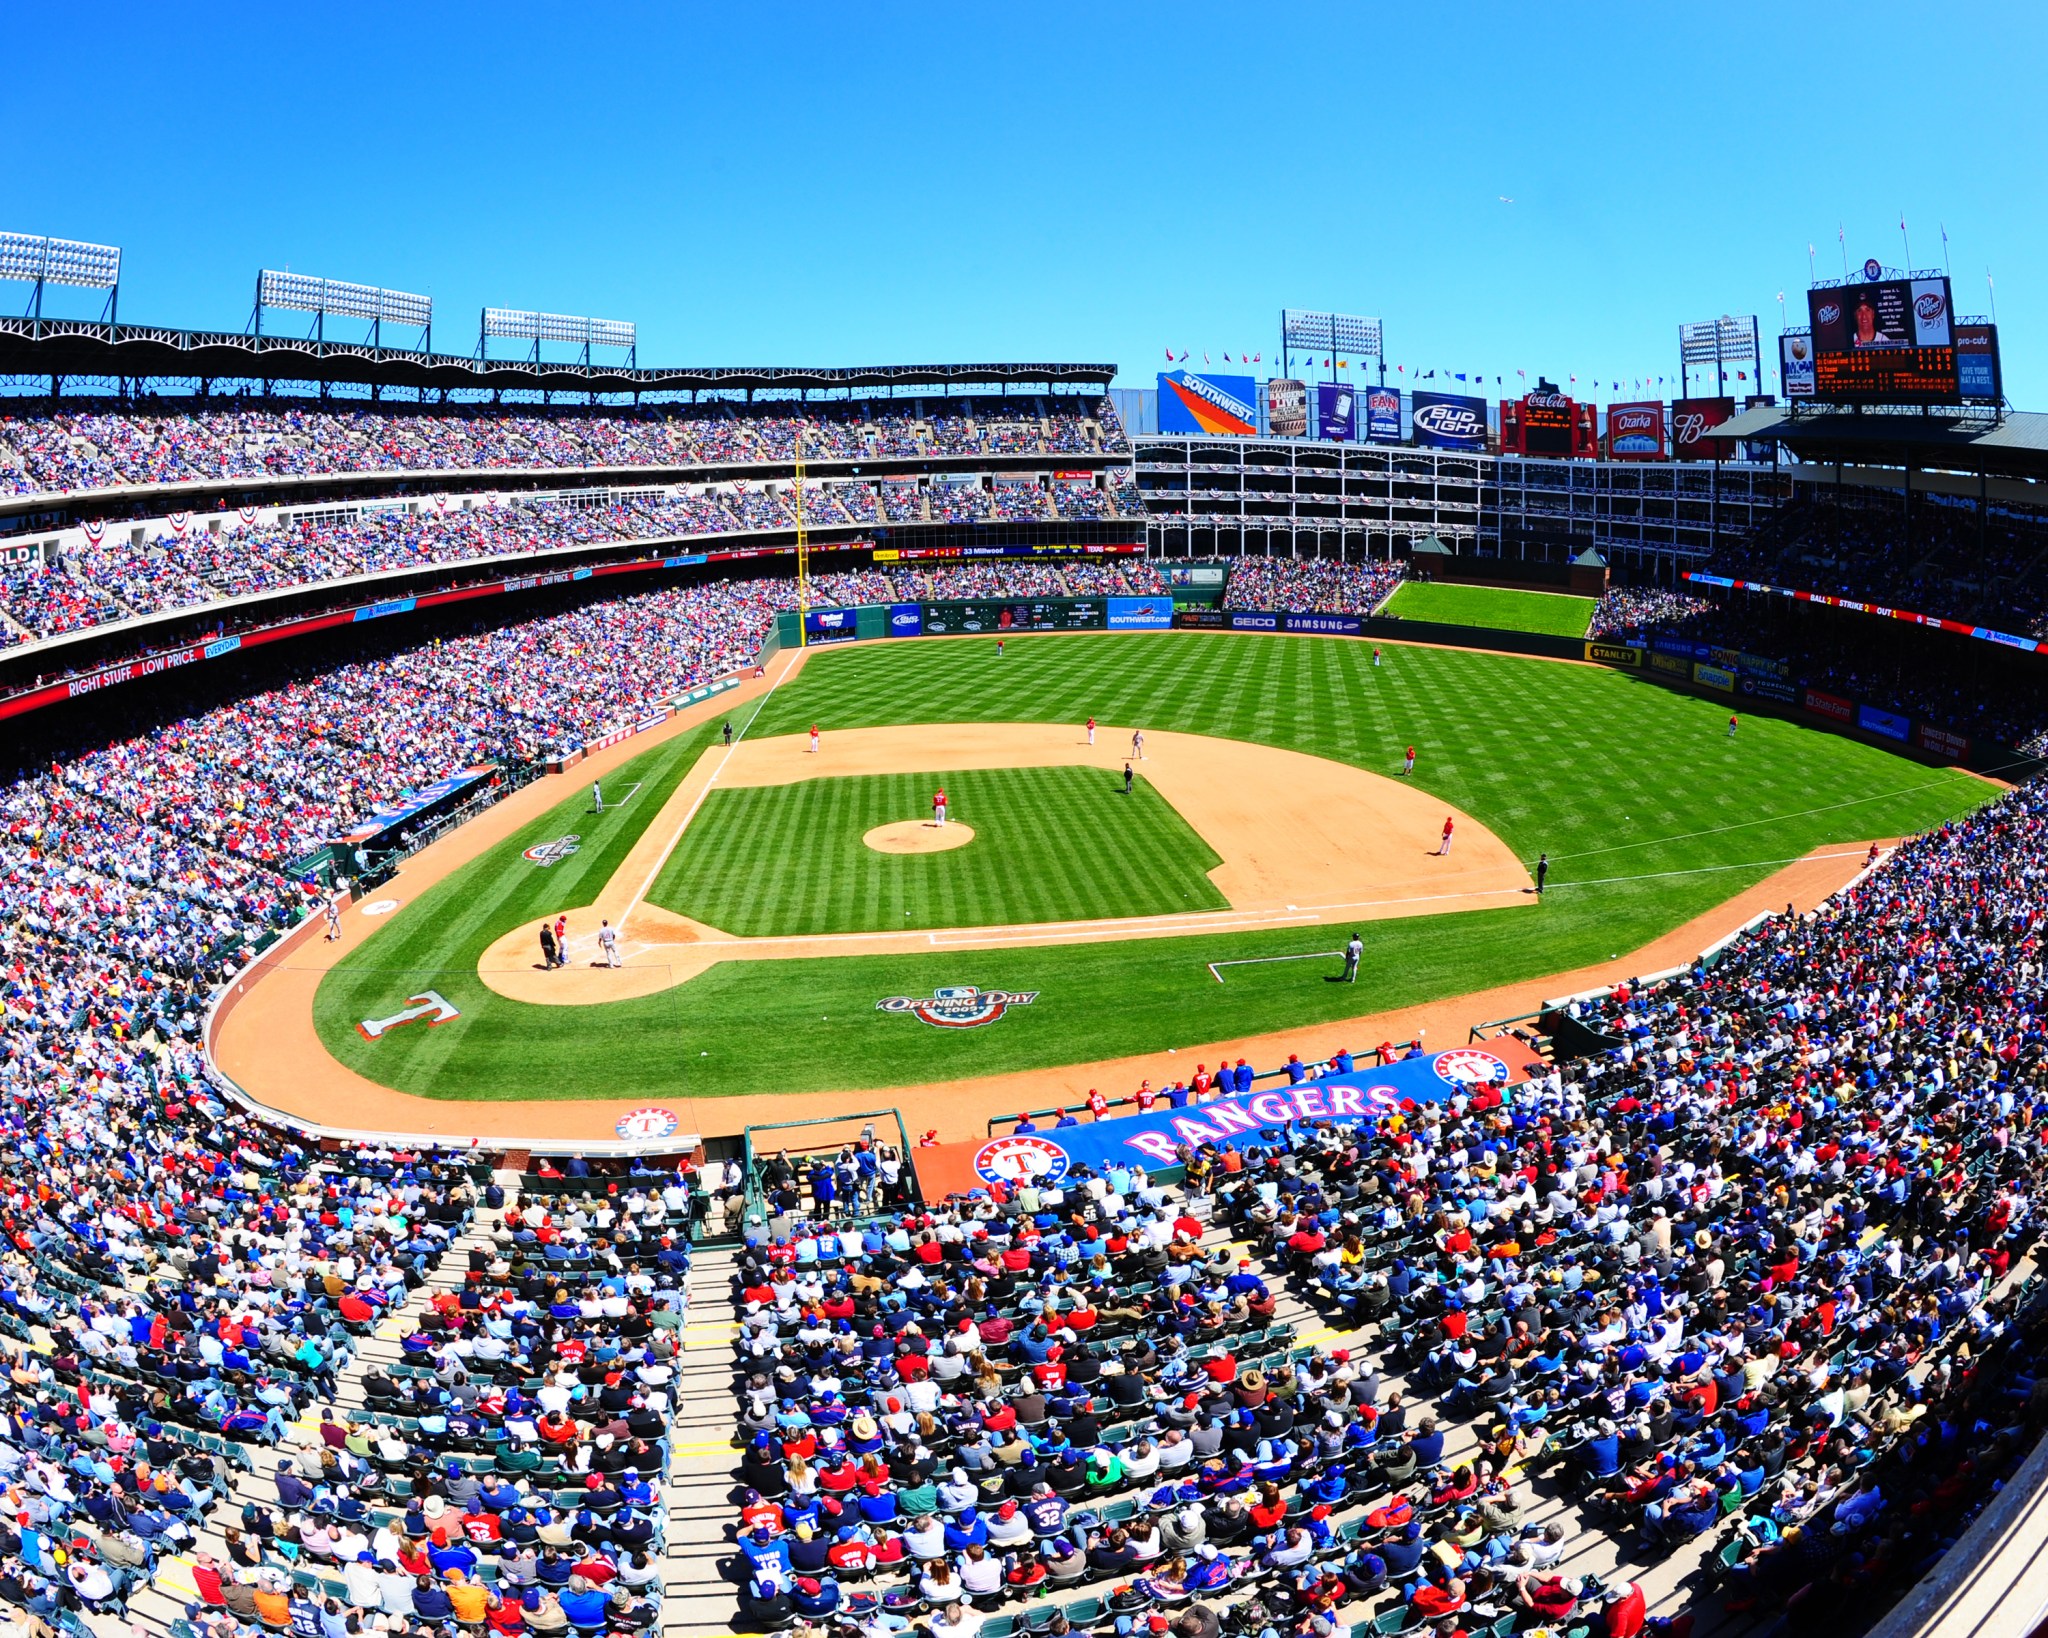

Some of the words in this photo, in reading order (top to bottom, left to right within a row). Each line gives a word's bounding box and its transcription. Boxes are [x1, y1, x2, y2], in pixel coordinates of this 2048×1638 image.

[1919, 299, 1940, 317] Pepper
[1957, 336, 1988, 347] pro-cuts
[1961, 376, 1971, 384] HAT
[1181, 374, 1254, 422] SOUTHWEST
[1269, 390, 1306, 400] RANGERS
[1276, 398, 1300, 408] LIVE
[1371, 396, 1397, 410] FAN
[1430, 408, 1476, 422] BUD
[1421, 417, 1484, 434] LIGHT
[1618, 415, 1652, 431] Ozarka
[504, 582, 521, 592] RIGHT
[541, 576, 554, 586] LOW
[1810, 594, 1826, 604] BALL
[1827, 597, 1832, 605] 2
[1839, 599, 1864, 611] STRIKE
[1864, 604, 1870, 613] 2
[1876, 607, 1892, 616] OUT
[1892, 610, 1897, 618] 1
[1110, 616, 1171, 624] SOUTHWEST.COM
[1232, 617, 1276, 627] GEICO
[1287, 619, 1343, 630] SAMSUNG
[205, 636, 241, 659] EVERYDAY!
[1655, 640, 1693, 653] SAMSUNG
[1593, 648, 1633, 661] STANLEY
[1711, 650, 1738, 665] SONIC
[1740, 655, 1765, 669] HAPPY
[68, 674, 101, 698] RIGHT
[103, 665, 135, 686] STUFF.
[141, 657, 165, 675] LOW
[167, 649, 198, 669] PRICE.
[1698, 666, 1730, 687] Snapple
[885, 997, 977, 1011] OPENING
[985, 992, 1034, 1005] DAY
[355, 988, 463, 1044] T
[944, 1005, 978, 1014] 2009
[1438, 1052, 1483, 1068] TEXAS
[1454, 1061, 1487, 1078] T
[1202, 1079, 1207, 1088] 7
[637, 1117, 659, 1132] T
[1123, 1084, 1400, 1166] RANGERS
[983, 1139, 1048, 1157] TEXAS
[1003, 1151, 1037, 1174] T
[1083, 1209, 1097, 1220] 56
[820, 1241, 834, 1252] 12
[1042, 1378, 1063, 1390] 34
[1611, 1397, 1626, 1414] 32
[1033, 1501, 1062, 1516] HAMILTON
[1039, 1509, 1061, 1528] 32
[470, 1529, 492, 1541] 32
[754, 1550, 781, 1562] YOUNG
[292, 1616, 318, 1634] 32
